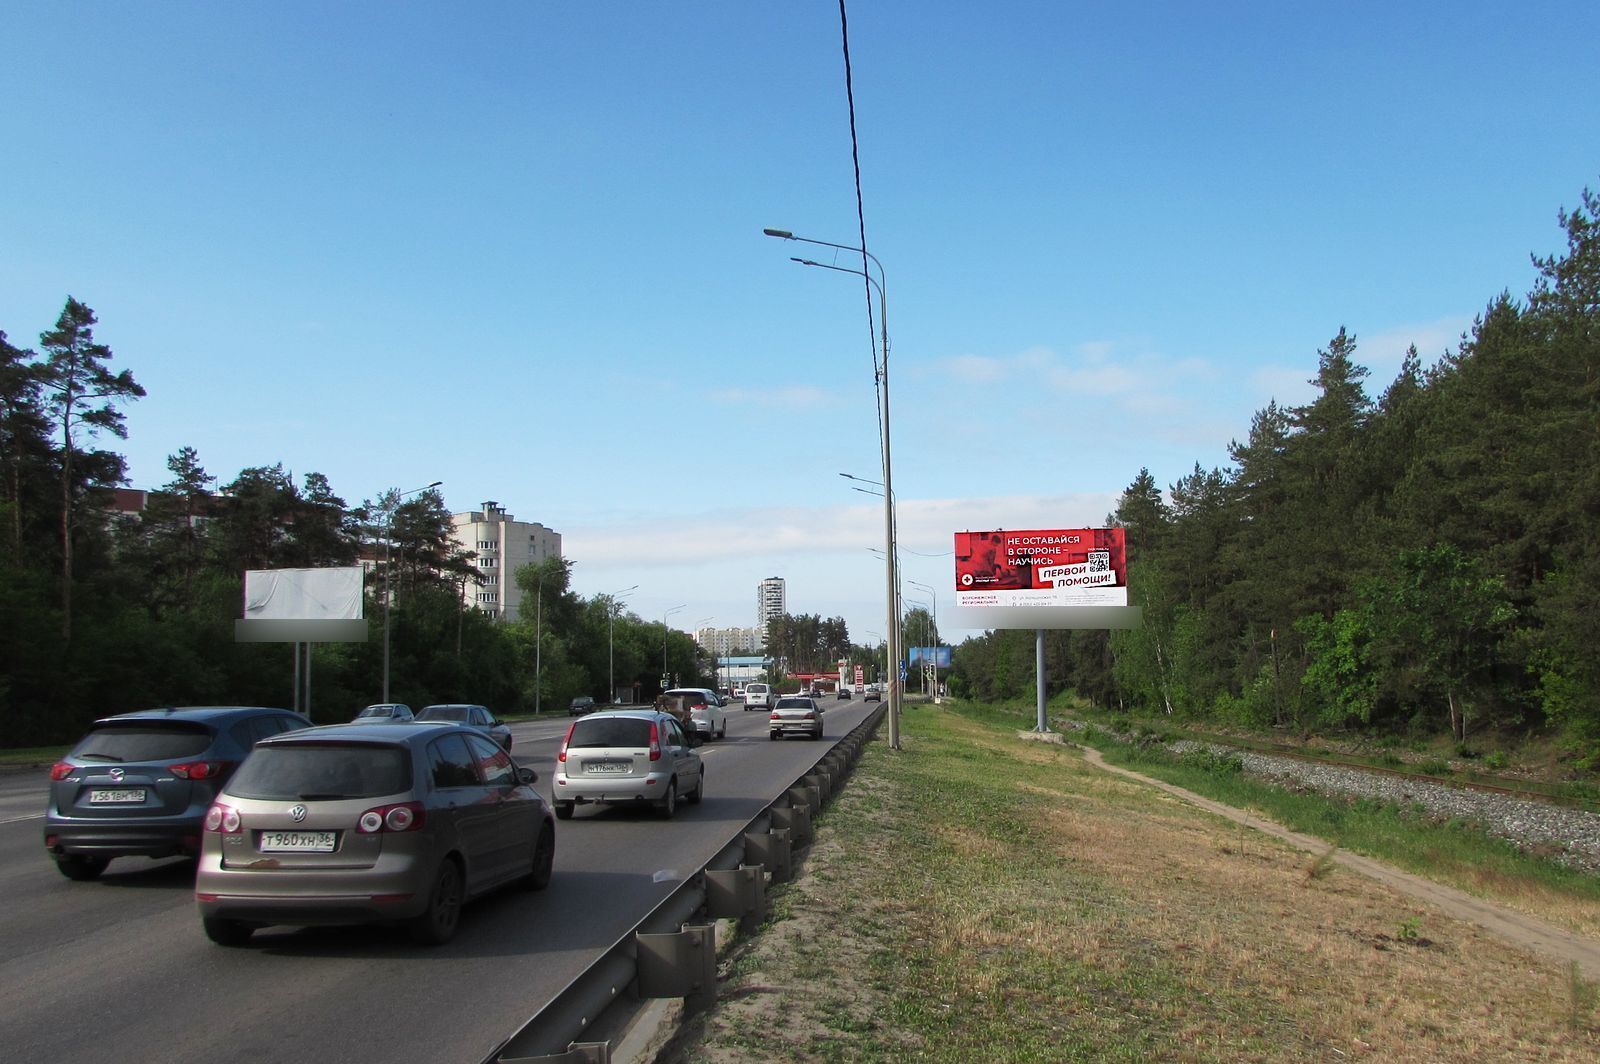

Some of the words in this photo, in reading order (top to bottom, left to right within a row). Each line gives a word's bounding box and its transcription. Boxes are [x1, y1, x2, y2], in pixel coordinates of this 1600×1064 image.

[1022, 535, 1080, 545] ОСТАВАЙСЯ
[1008, 548, 1015, 556] В
[1016, 547, 1061, 555] СТОРОНЕ
[1008, 557, 1054, 566] НАУЧИСЬ
[1043, 565, 1087, 578] ПЕРВОЙ
[1057, 574, 1111, 587] ПОМОЩИ!
[266, 833, 316, 846] Т960ХН
